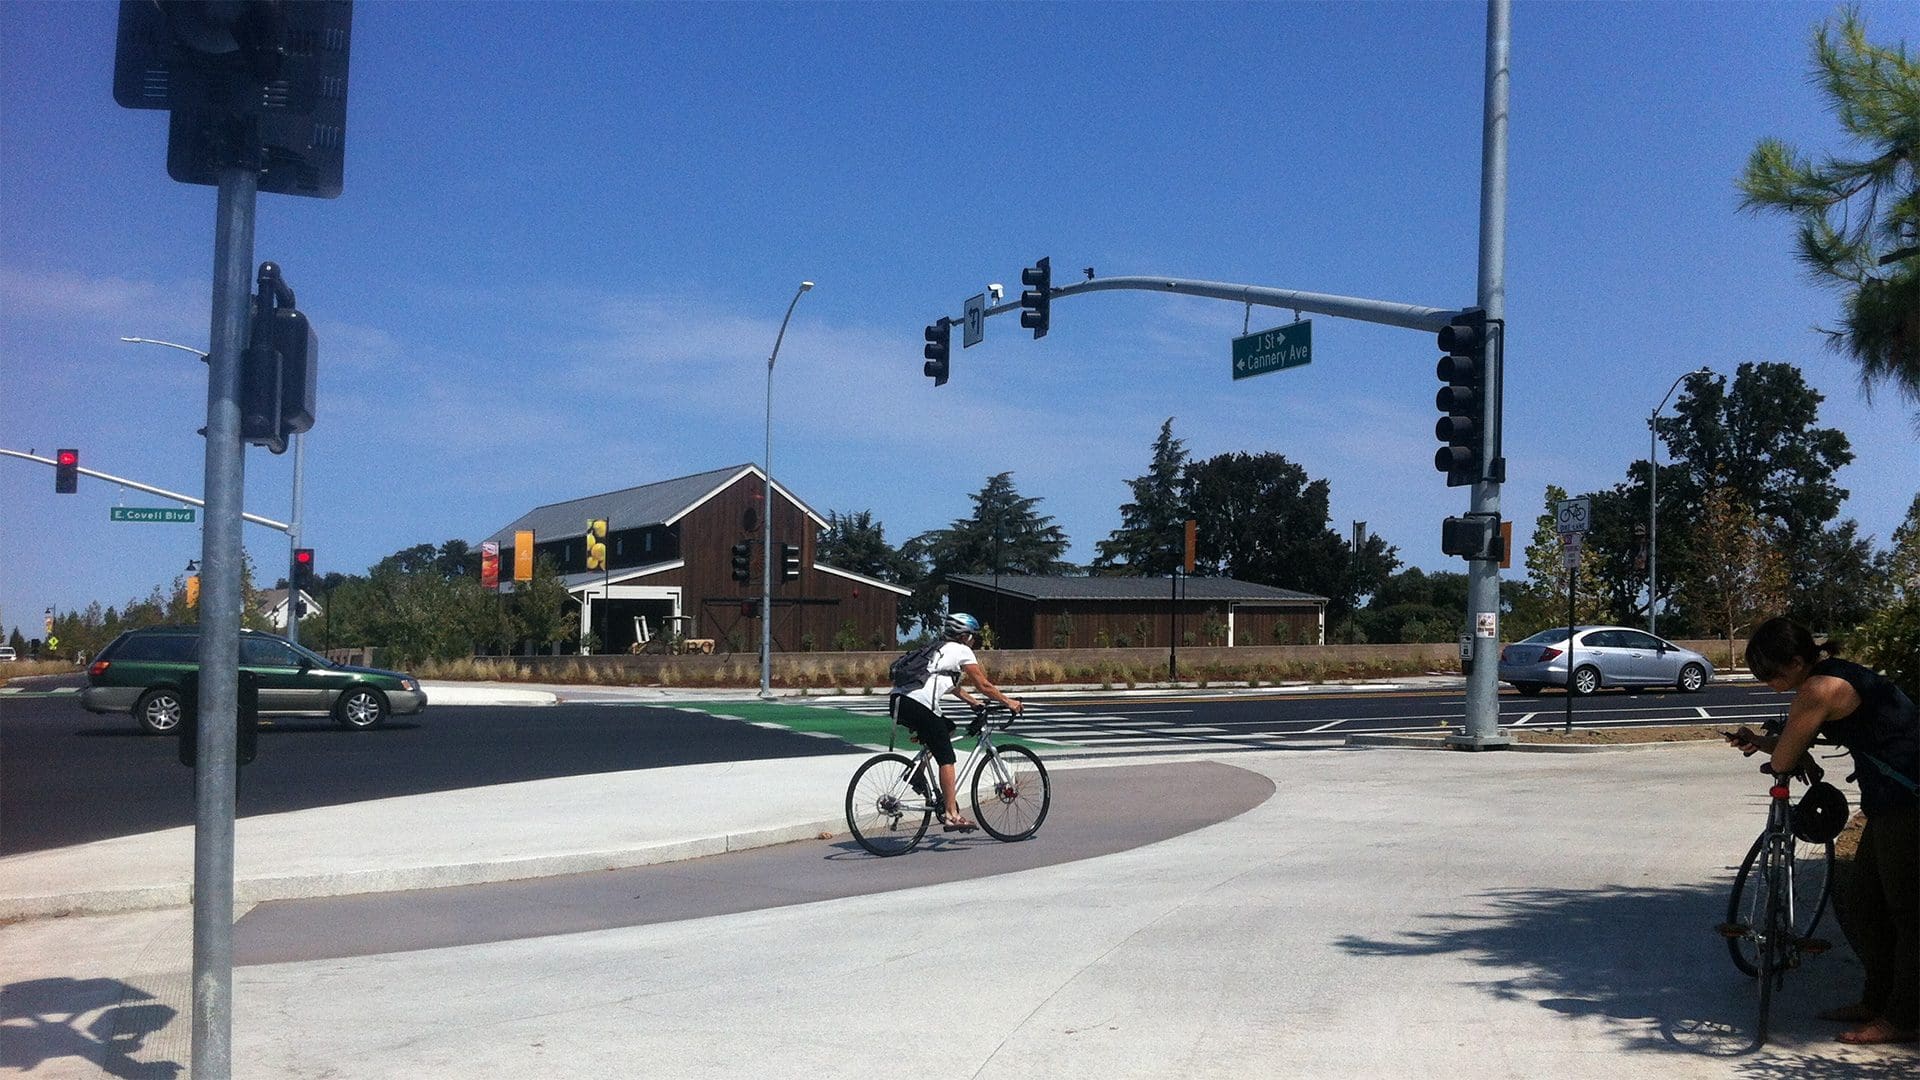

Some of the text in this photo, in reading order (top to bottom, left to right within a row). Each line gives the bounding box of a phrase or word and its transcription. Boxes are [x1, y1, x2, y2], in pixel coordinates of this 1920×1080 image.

[1256, 333, 1275, 352] J St
[1247, 344, 1308, 370] Cannery Ave
[127, 511, 162, 520] Covell
[165, 511, 191, 520] Blvd
